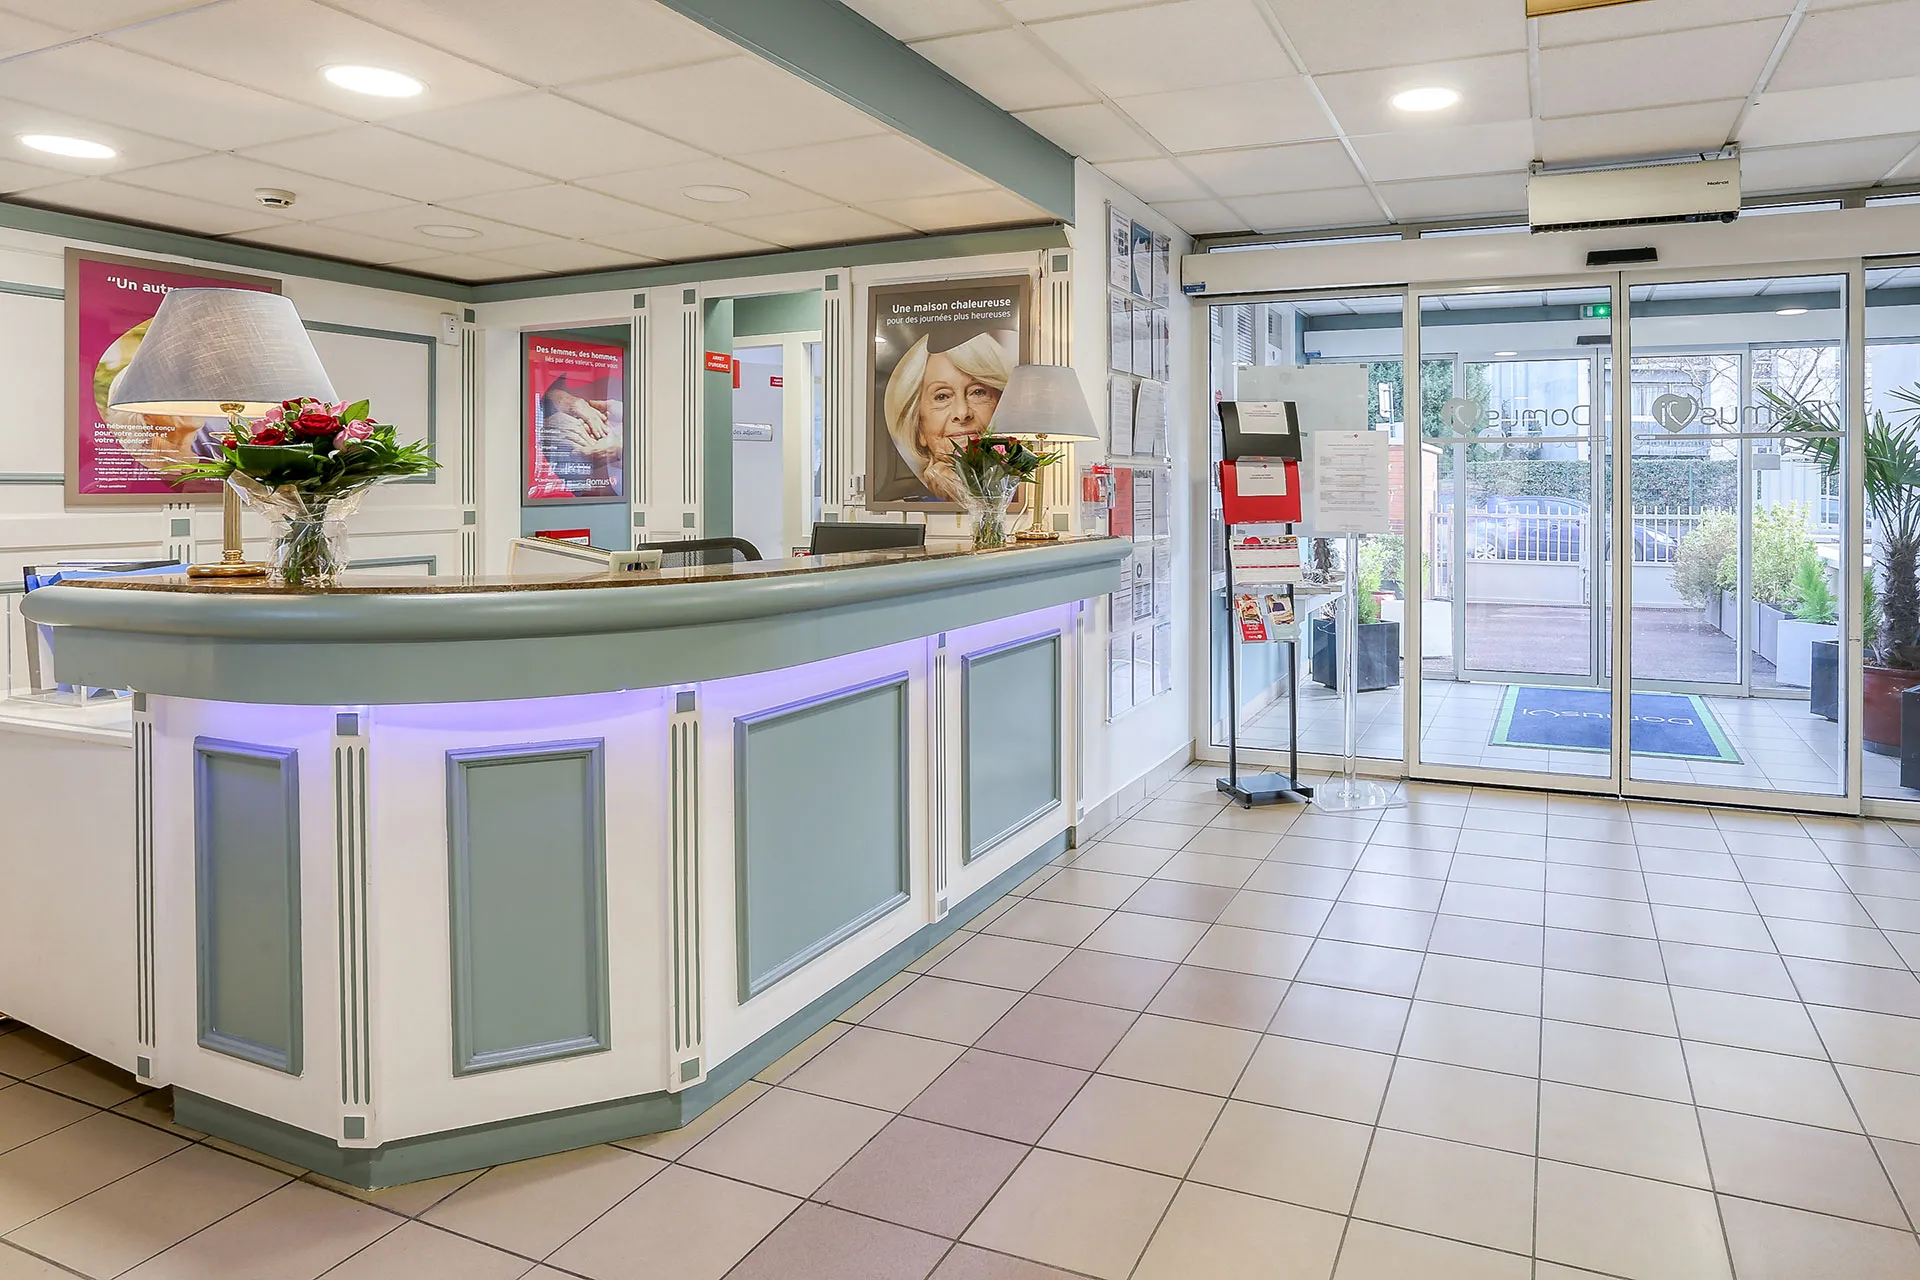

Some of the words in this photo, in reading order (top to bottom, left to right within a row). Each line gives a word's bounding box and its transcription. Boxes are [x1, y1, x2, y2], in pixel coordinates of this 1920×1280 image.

[892, 304, 911, 314] Une
[913, 302, 948, 312] maison
[951, 298, 1011, 310] chaleureuse
[886, 317, 903, 326] pour
[905, 316, 918, 324] des
[919, 313, 952, 324] journées
[953, 312, 969, 322] plus
[971, 310, 1011, 319] heureuses
[536, 345, 549, 354] Des
[550, 347, 578, 357] femmes,
[579, 350, 590, 358] des
[591, 352, 618, 362] hommes,
[106, 422, 154, 431] hébergement
[154, 424, 176, 432] conçu
[115, 436, 149, 444] réconfort
[133, 430, 159, 438] confort
